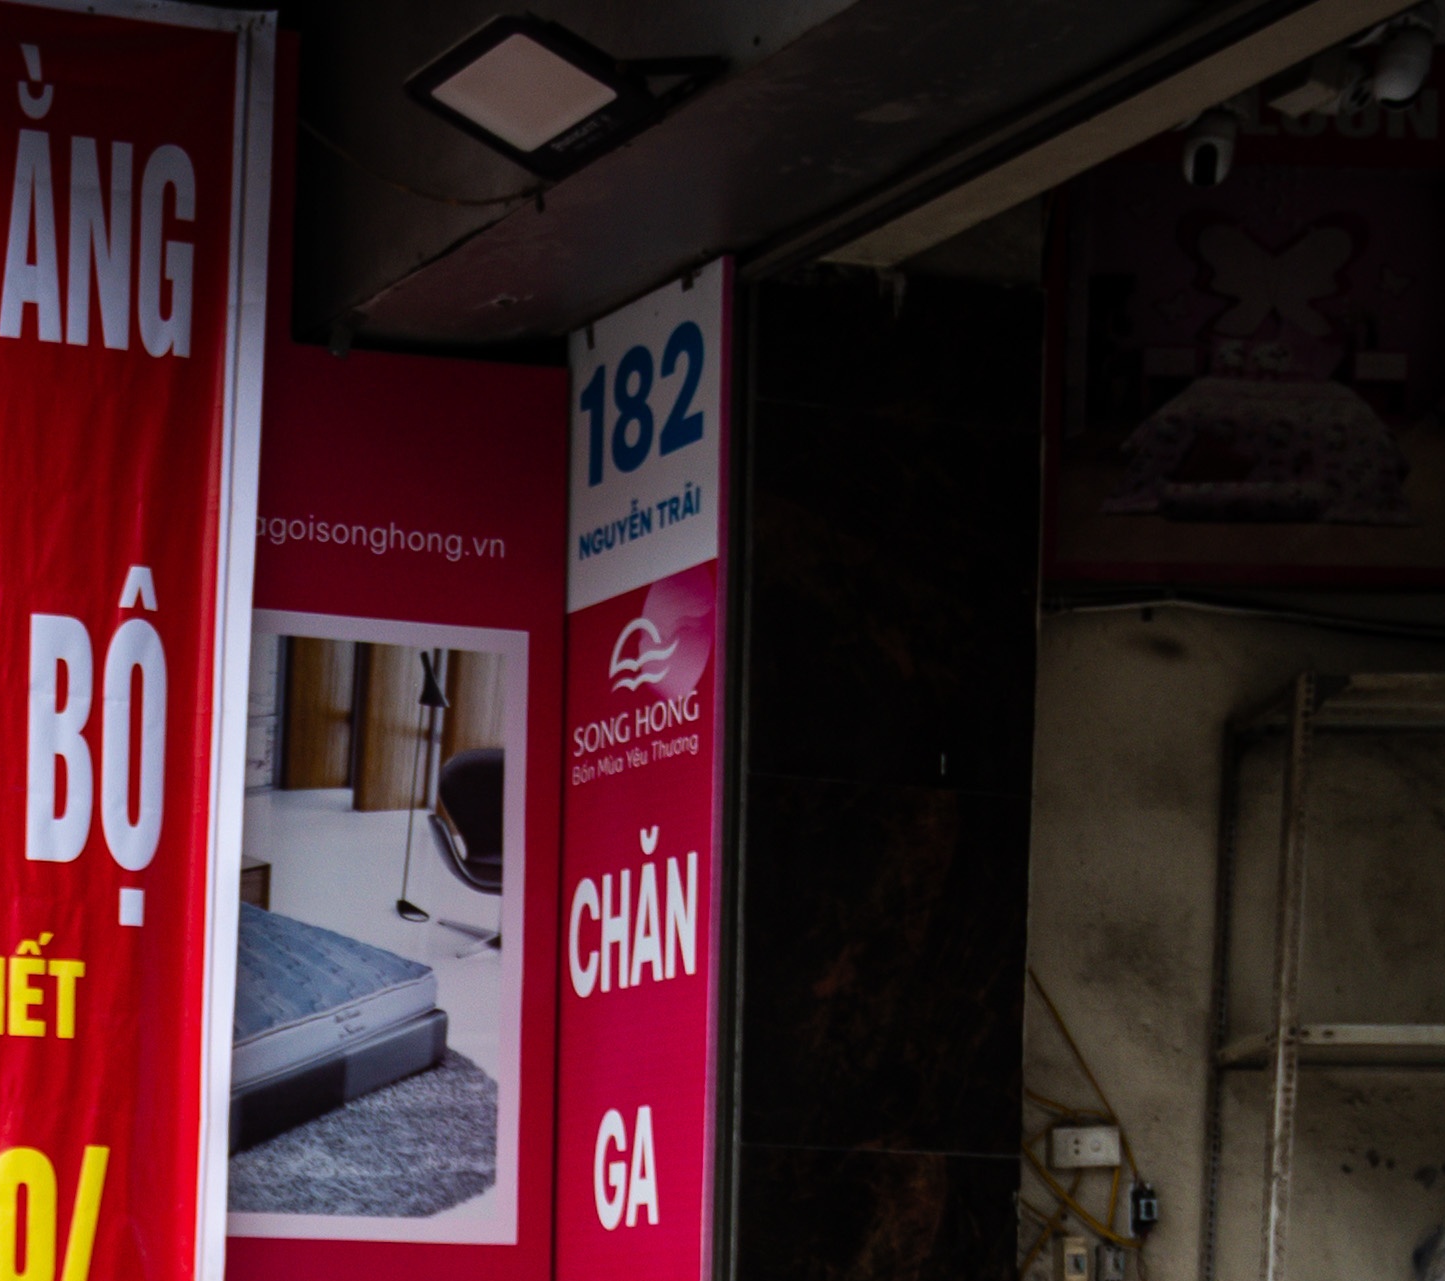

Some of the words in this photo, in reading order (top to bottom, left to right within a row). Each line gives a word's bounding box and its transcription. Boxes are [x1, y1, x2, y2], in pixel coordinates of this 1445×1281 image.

[580, 320, 705, 487] 182
[579, 499, 652, 560] NGUYỄN
[656, 482, 701, 527] TRÃI
[26, 566, 168, 926] BỘ
[573, 711, 630, 757] SONG
[635, 691, 701, 738] HONG
[568, 825, 698, 999] CHĂN
[594, 1105, 658, 1231] GA
